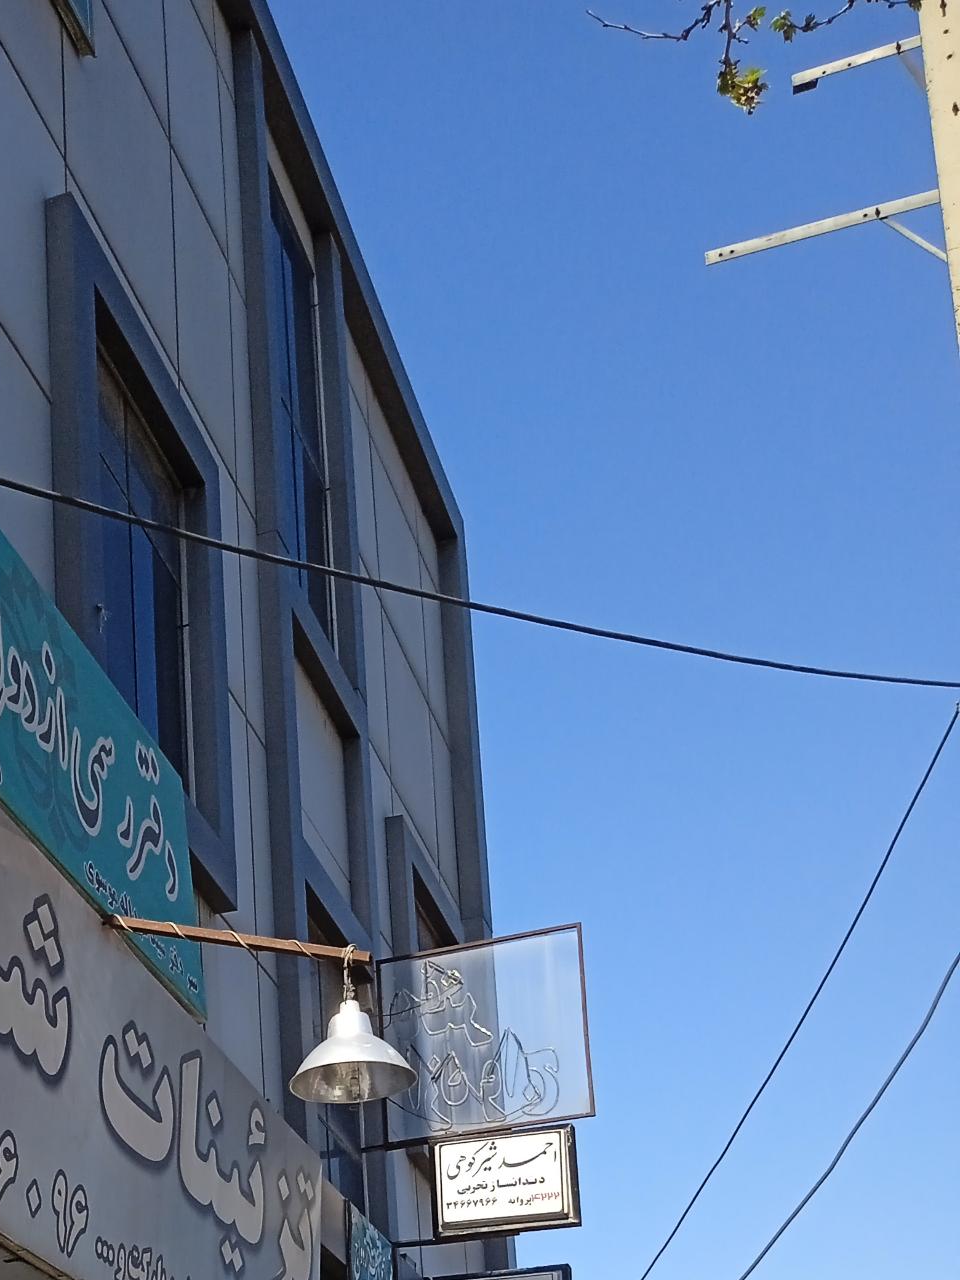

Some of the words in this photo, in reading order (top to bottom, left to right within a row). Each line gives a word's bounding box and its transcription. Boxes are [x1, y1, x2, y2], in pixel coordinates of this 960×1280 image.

[70, 726, 135, 848] رسمی
[126, 739, 179, 902] دفتر
[498, 1141, 558, 1170] احمد
